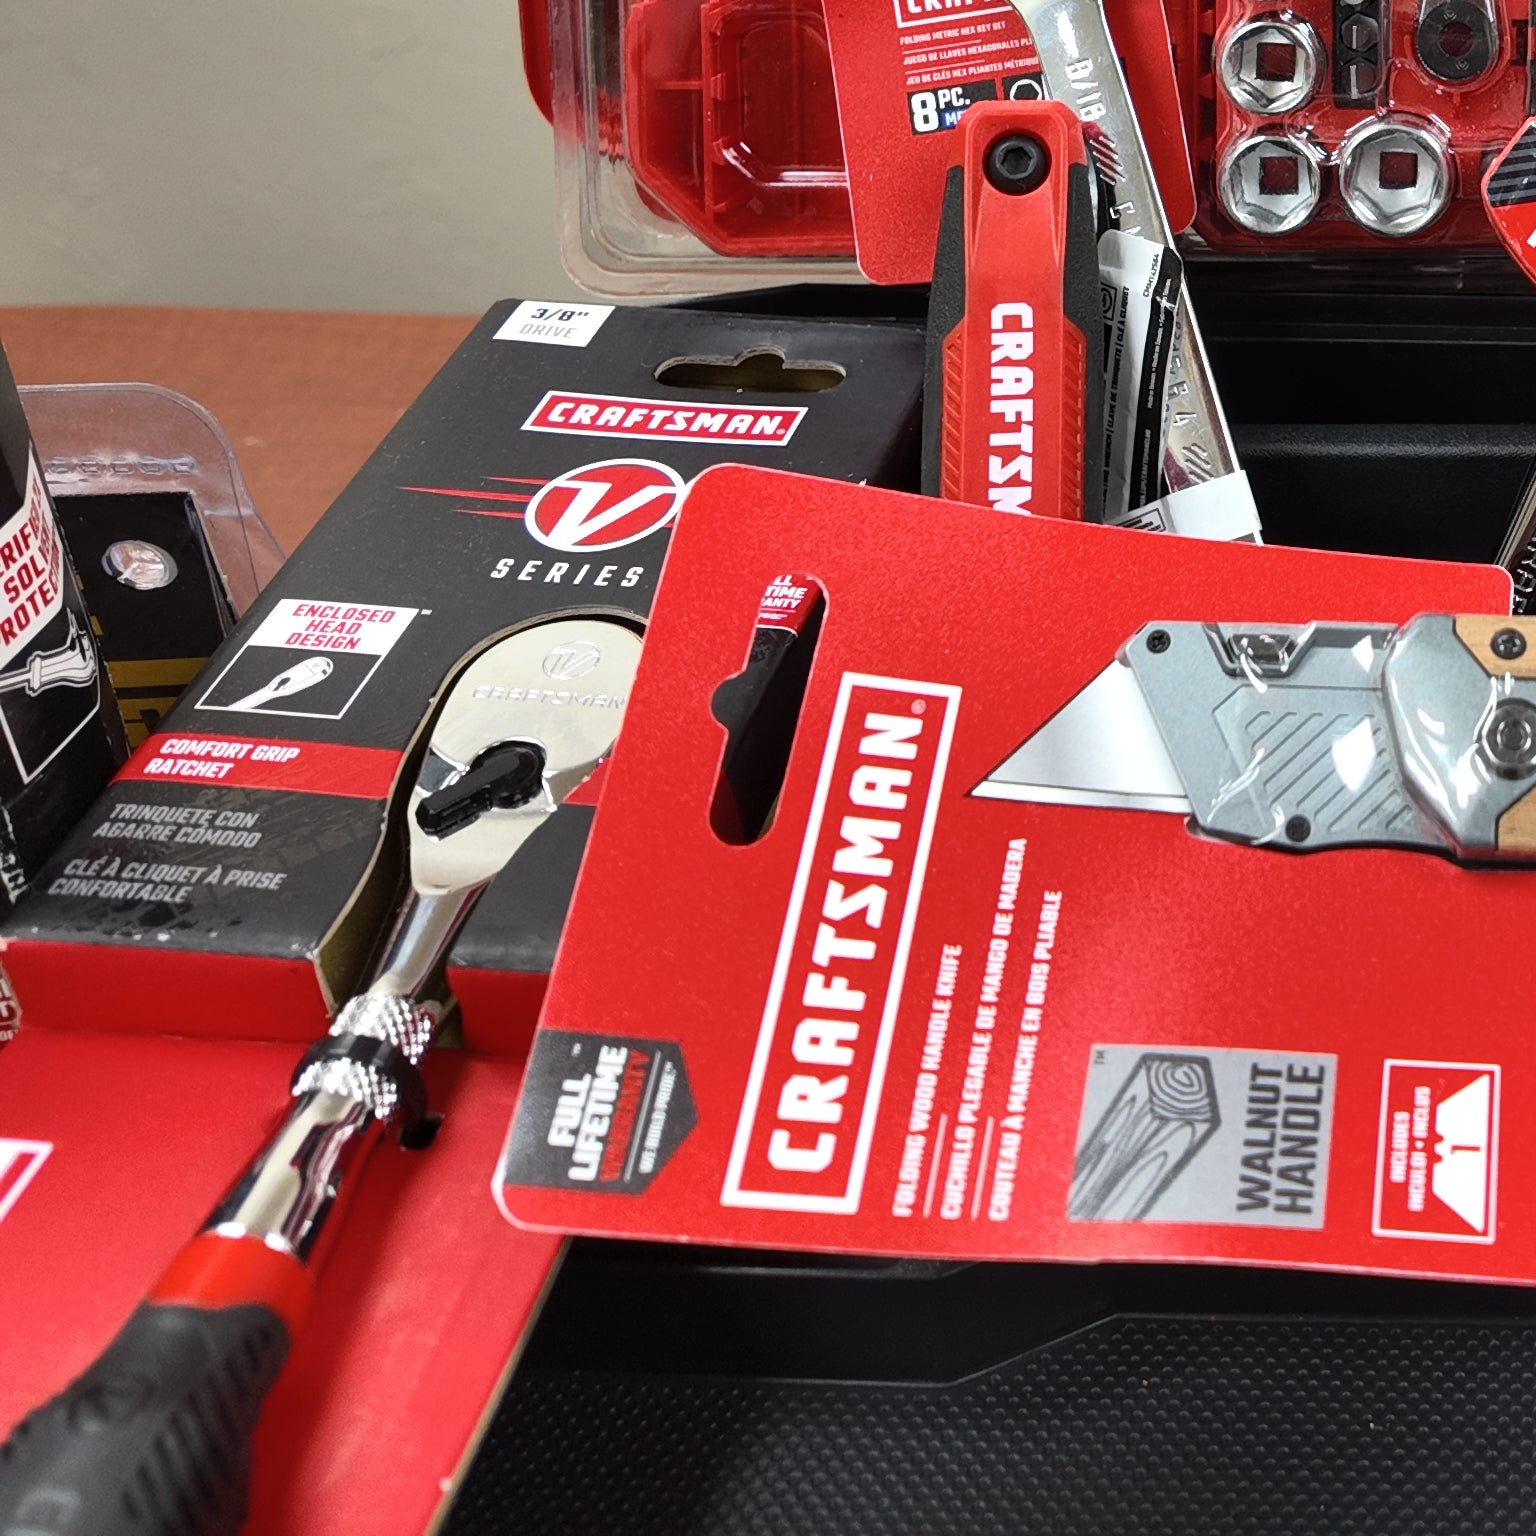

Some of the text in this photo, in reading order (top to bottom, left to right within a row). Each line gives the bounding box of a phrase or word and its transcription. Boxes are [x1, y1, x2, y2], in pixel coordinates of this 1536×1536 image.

[911, 91, 938, 133] 8
[938, 87, 970, 109] PC.
[519, 324, 576, 338] DRIVE
[490, 558, 644, 588] SERIES
[291, 604, 395, 624] ENCLOSED
[305, 620, 362, 636] HEAD
[285, 632, 360, 651] DESIGN
[160, 738, 300, 763] COMFORT GRIP
[143, 758, 235, 778] RATCHET
[109, 803, 260, 828] TRINQUETE CON
[93, 822, 262, 848] AGARRE CÓMODO
[48, 878, 193, 903] CONFORTABLE
[940, 838, 1027, 1220] CUCHILLO PLEGABLE DE MANGO DE MADERA
[988, 890, 1062, 1222] COUTEAU À MANCHE EN BOIS PLIABLE
[891, 944, 962, 1218] FOLDING WOOD HANDLE KNIFE
[547, 1073, 592, 1148] FULL
[567, 1045, 628, 1181] LIFETIME
[1235, 1062, 1285, 1214] WALNUT
[1273, 1063, 1326, 1215] HANDLE
